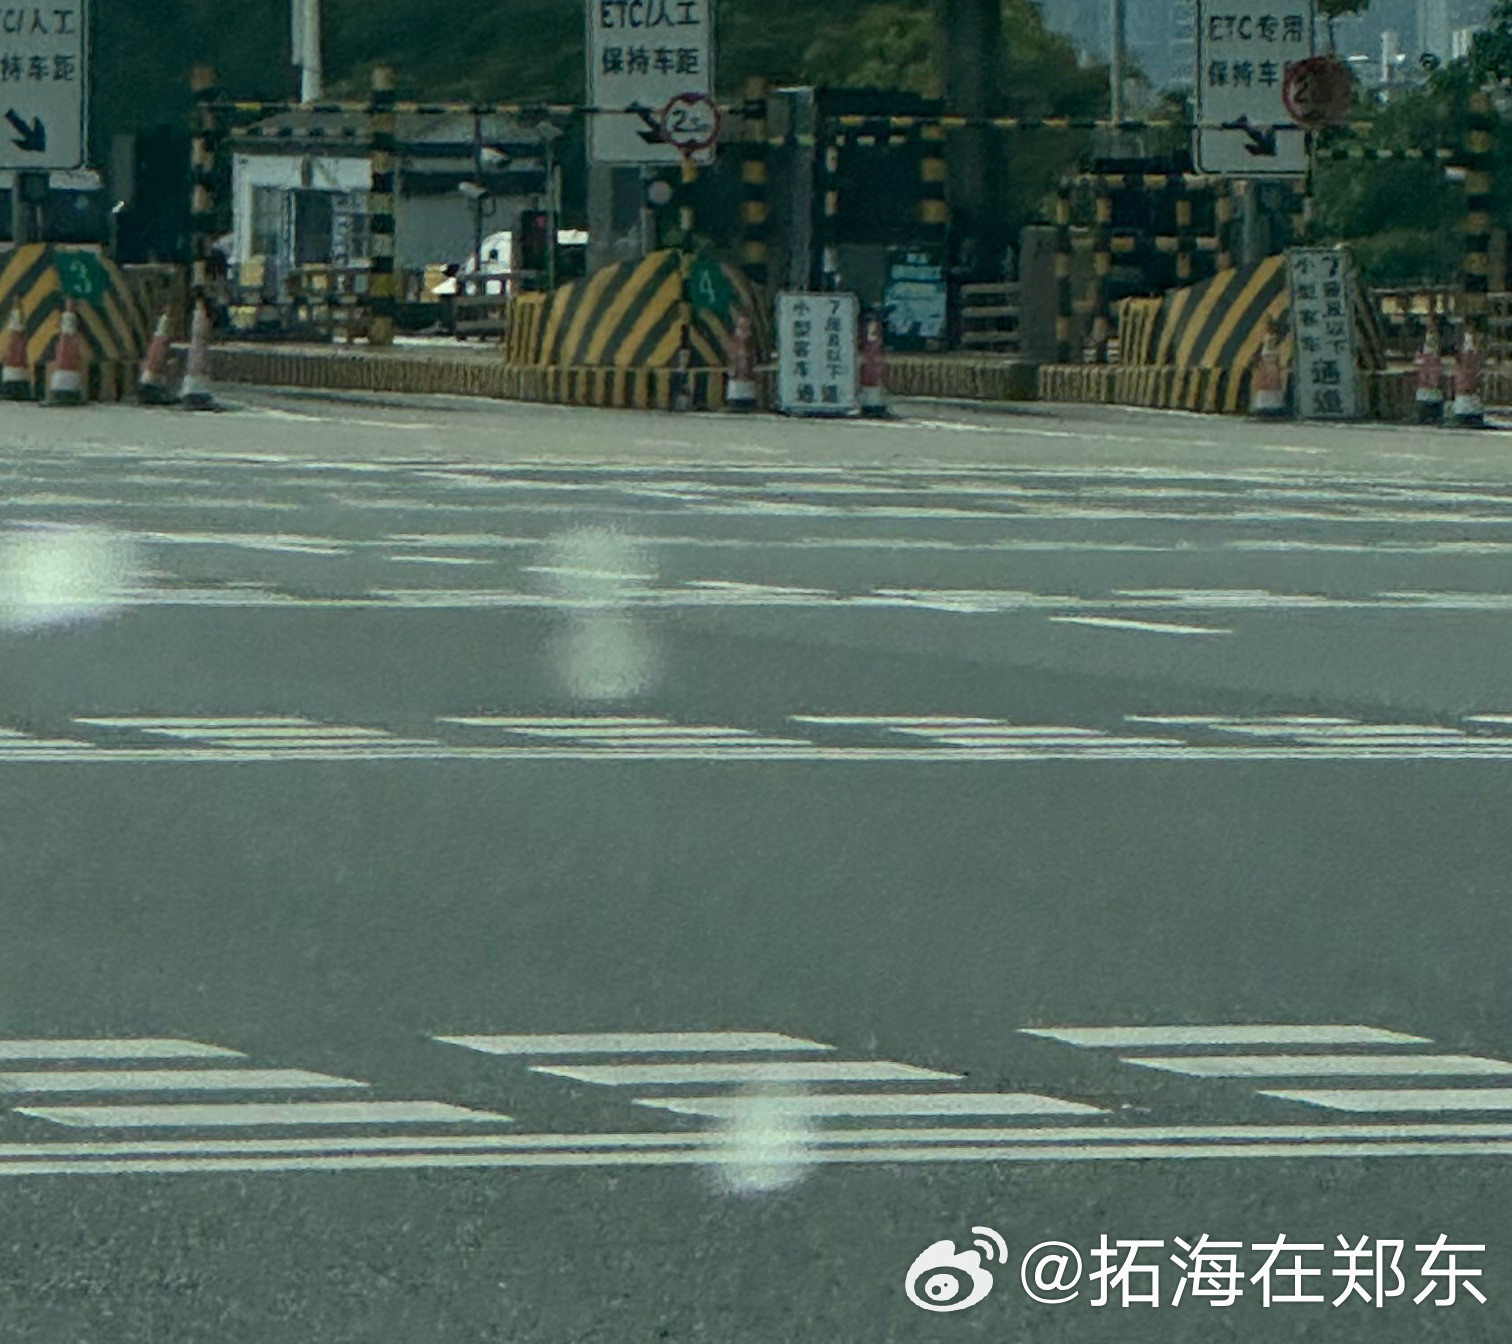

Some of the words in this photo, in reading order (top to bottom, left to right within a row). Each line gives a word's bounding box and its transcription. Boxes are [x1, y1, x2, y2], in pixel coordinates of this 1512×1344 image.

[1209, 14, 1303, 42] ETC专用
[602, 46, 699, 75] 保持车距
[1208, 59, 1292, 88] 保持车
[70, 261, 92, 293] 3
[699, 270, 716, 303] 4
